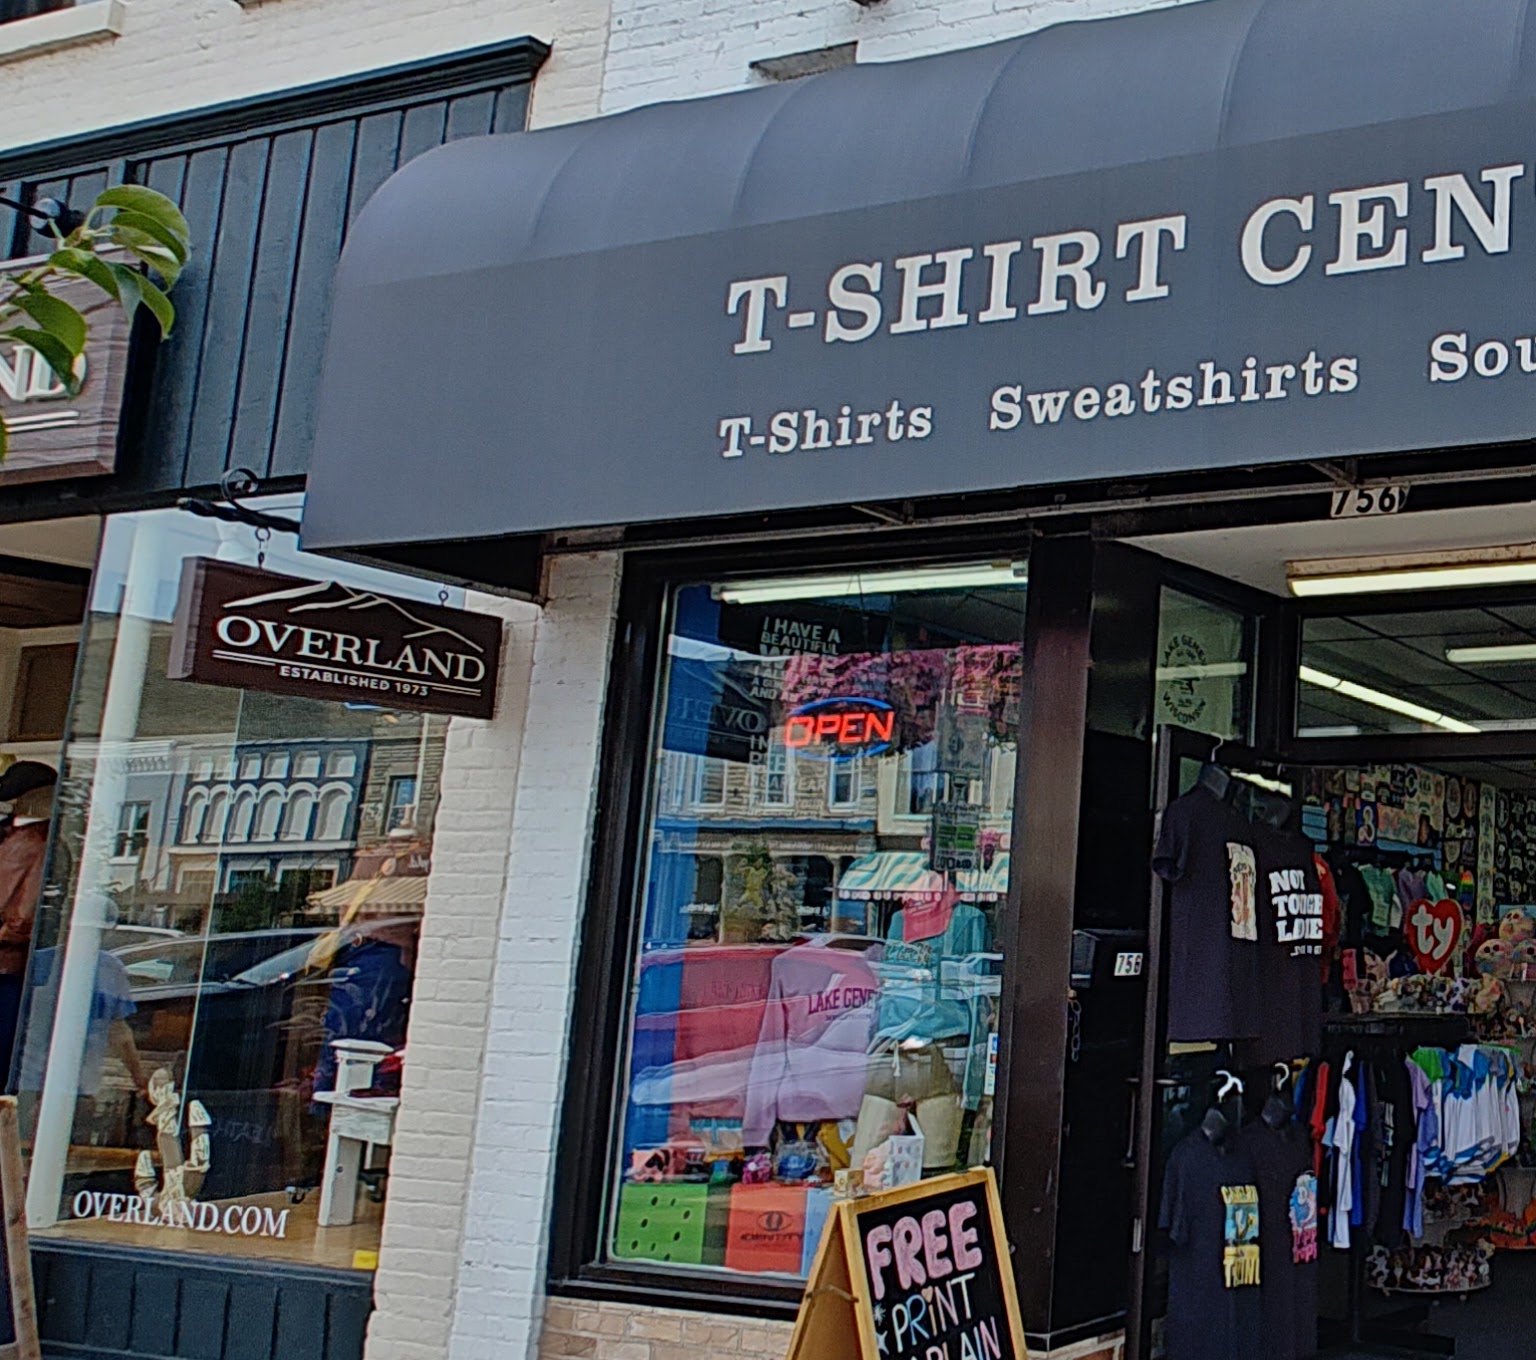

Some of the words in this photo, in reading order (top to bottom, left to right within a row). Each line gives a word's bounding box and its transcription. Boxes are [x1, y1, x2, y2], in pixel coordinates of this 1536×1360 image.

[727, 215, 1186, 354] T-SHIRT
[719, 400, 932, 458] T-Shirts
[989, 351, 1358, 430] Sweatshirts
[1333, 486, 1396, 515] 756
[217, 615, 486, 682] OVERLAND
[761, 630, 839, 656] BEAUTIFUL
[774, 618, 823, 640] HAVE
[827, 628, 841, 643] A
[279, 665, 391, 691] ESTABLISHED
[395, 682, 428, 697] 1973
[784, 710, 895, 749] OPEN
[1411, 904, 1454, 960] ty
[1118, 954, 1141, 974] 756
[808, 988, 840, 1015] LAKE
[73, 1190, 291, 1239] OVERLAND.COM
[867, 1200, 983, 1300] FREE
